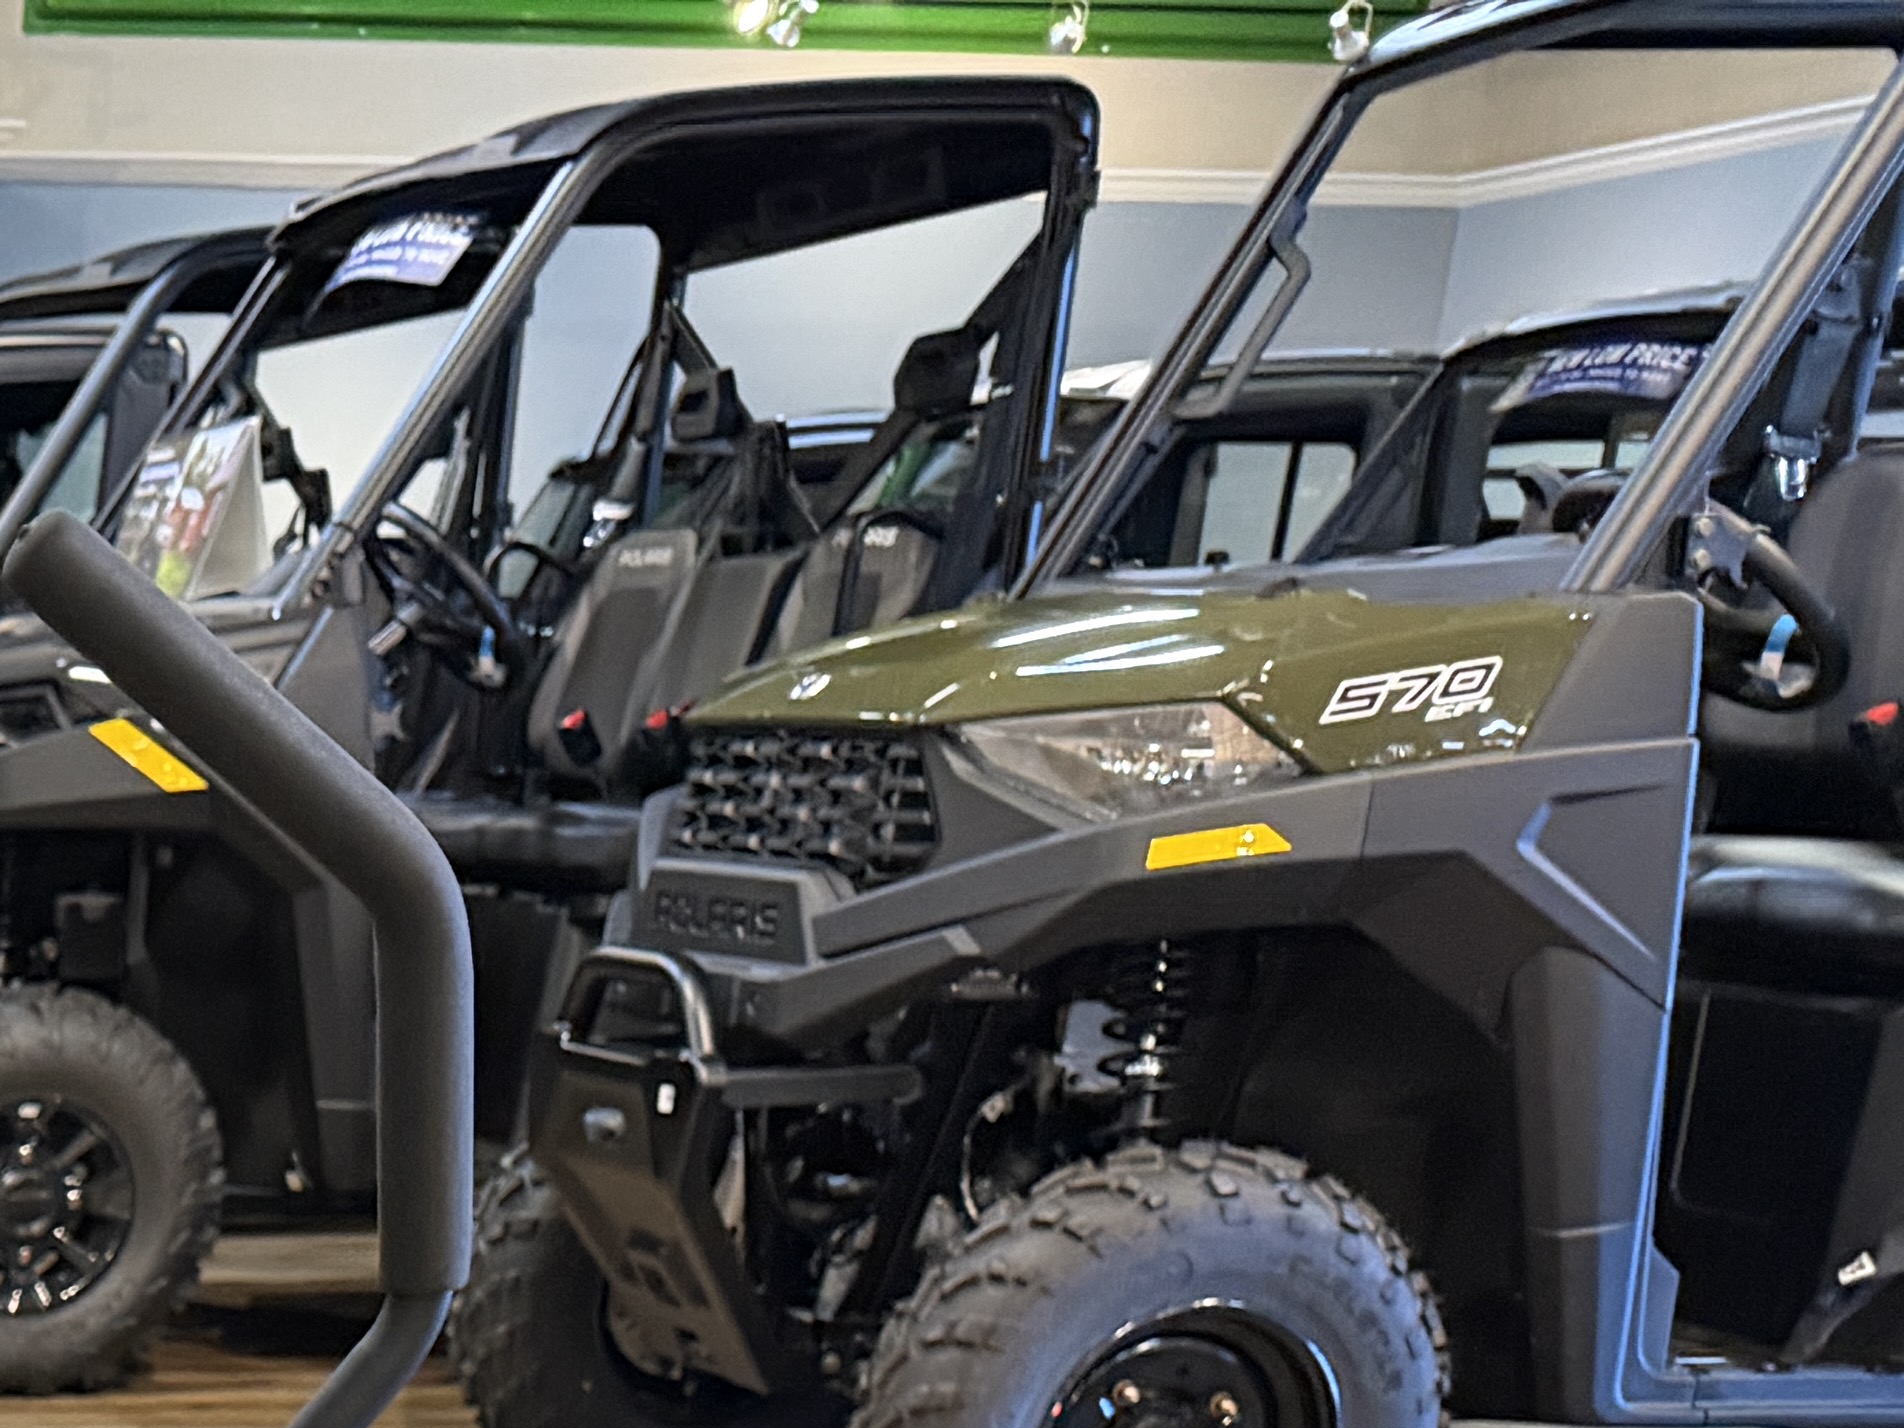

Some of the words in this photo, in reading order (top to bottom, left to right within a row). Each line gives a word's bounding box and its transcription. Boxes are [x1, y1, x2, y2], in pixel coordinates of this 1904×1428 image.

[1319, 656, 1503, 725] 570
[1424, 697, 1494, 723] EFI
[654, 892, 778, 945] POLARIS
